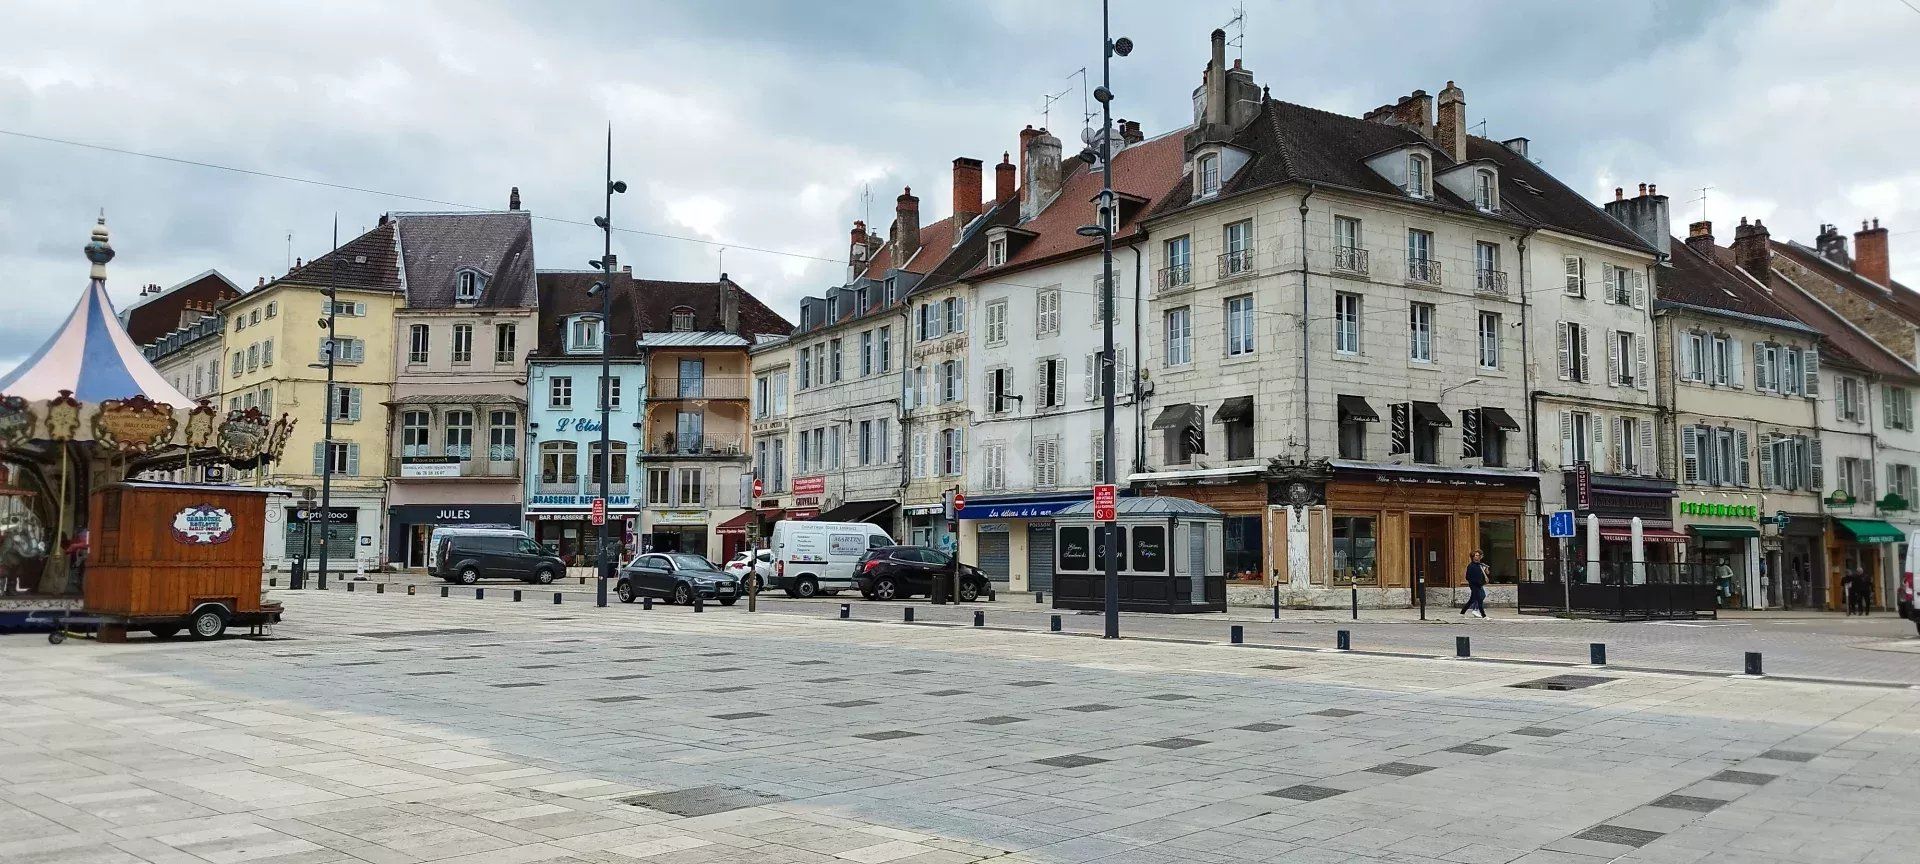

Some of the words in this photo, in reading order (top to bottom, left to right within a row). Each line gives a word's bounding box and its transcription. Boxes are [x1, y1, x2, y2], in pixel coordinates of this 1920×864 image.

[555, 417, 603, 432] L'Etoi
[533, 495, 576, 504] BRASSERIE
[580, 495, 630, 504] RESRANT
[436, 509, 471, 519] JULES
[989, 509, 999, 517] Les
[1031, 508, 1037, 516] la
[1680, 502, 1757, 517] PHARMACIE
